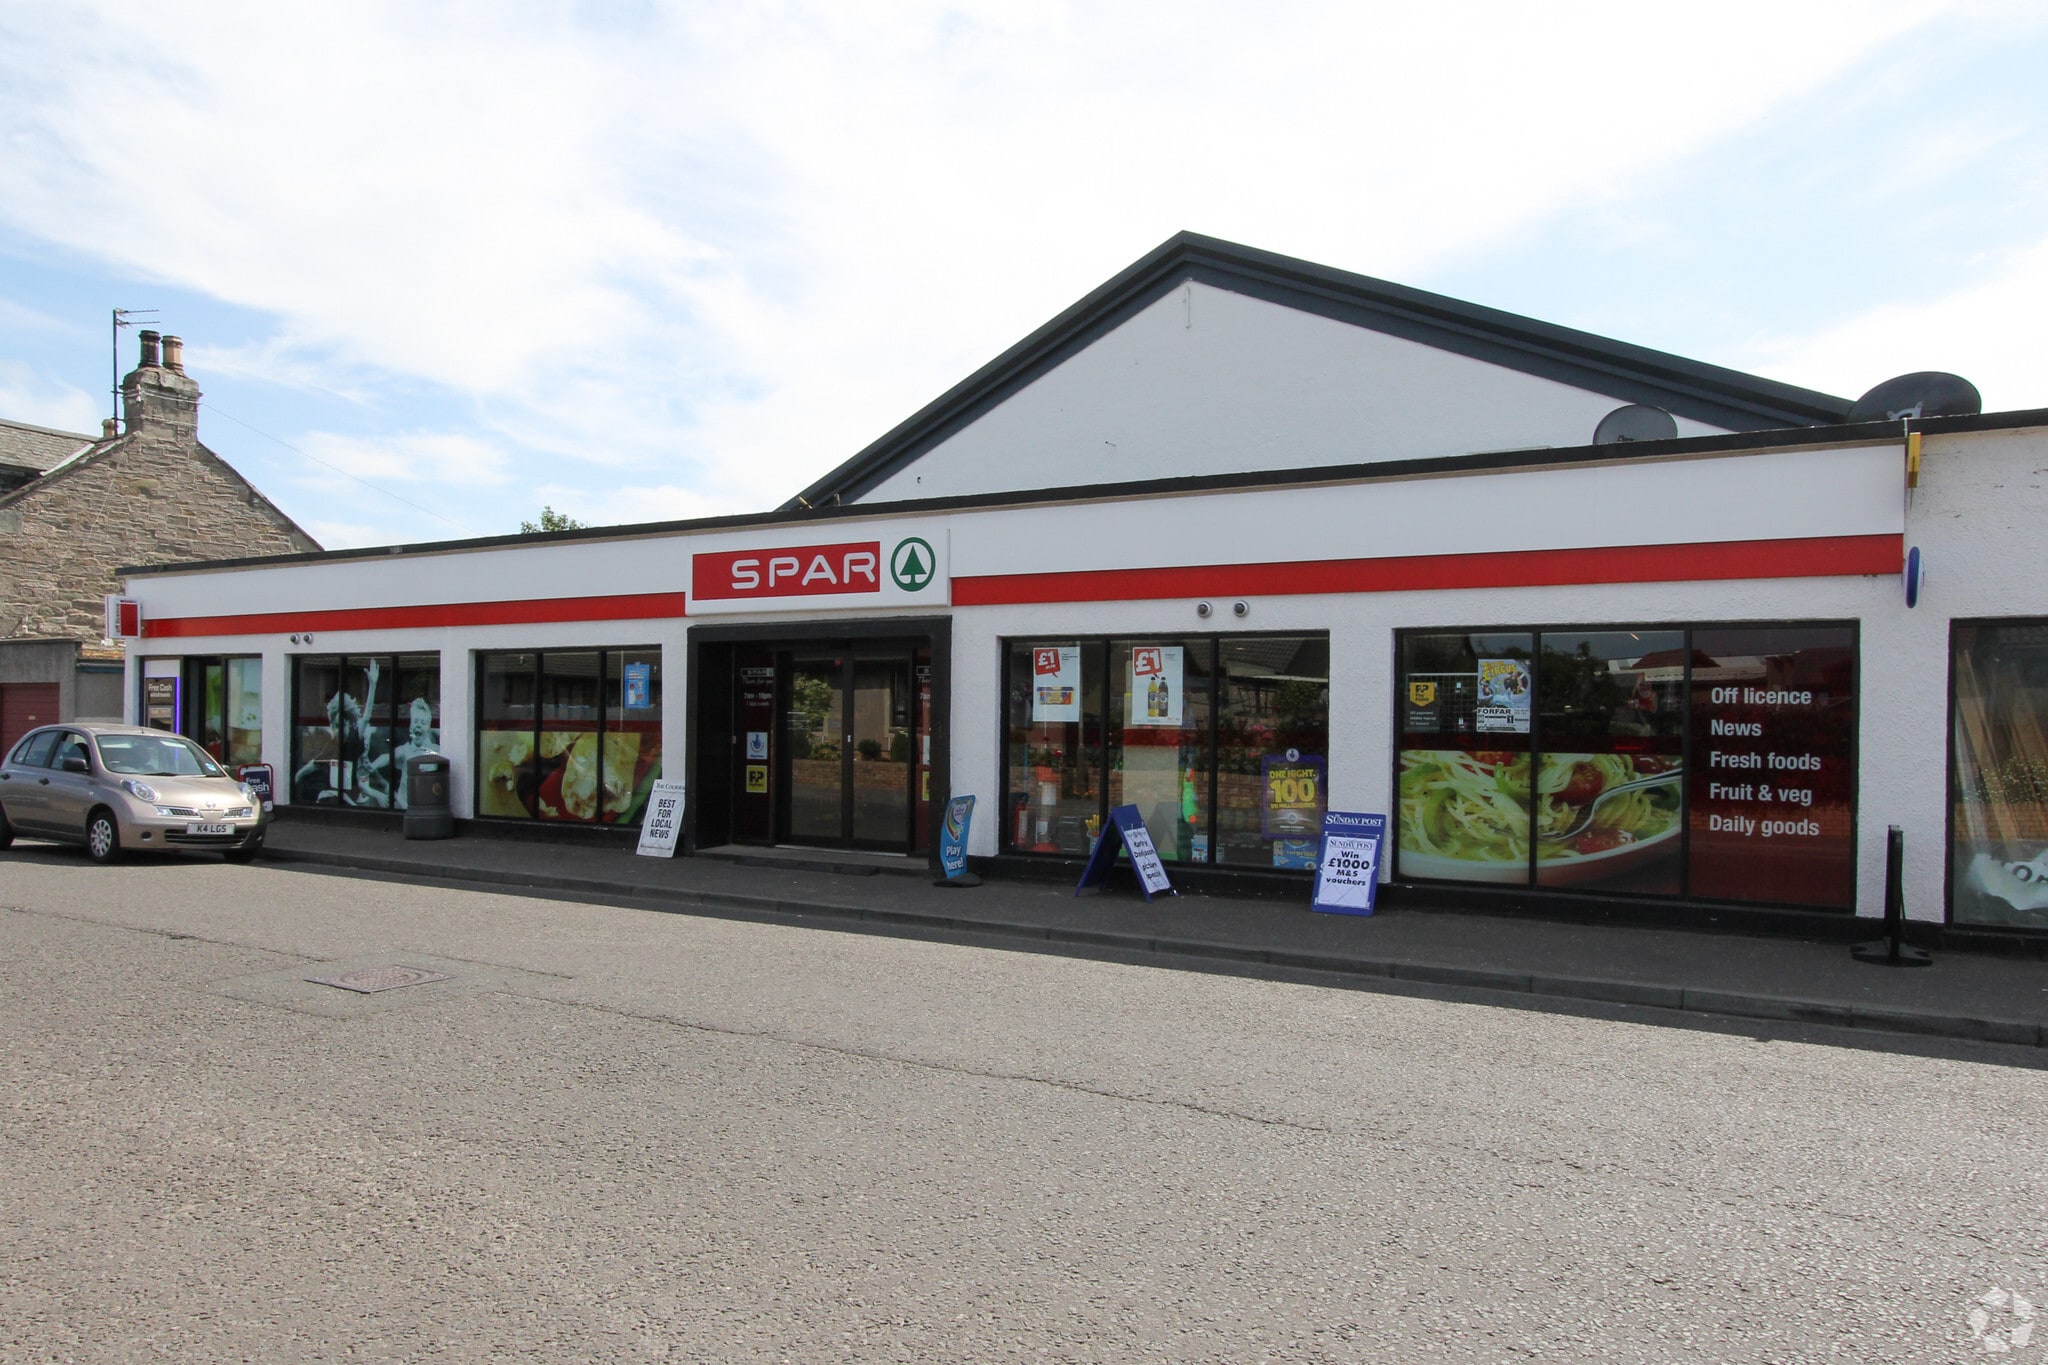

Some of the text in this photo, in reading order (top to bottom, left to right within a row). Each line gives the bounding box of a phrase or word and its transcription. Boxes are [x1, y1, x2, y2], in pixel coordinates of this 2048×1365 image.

[731, 552, 876, 590] SPAR
[1038, 651, 1055, 666] £1
[1136, 650, 1160, 672] £1
[1483, 664, 1517, 682] CIRCUS
[1711, 687, 1812, 704] Off licence
[1711, 719, 1762, 736] News
[1710, 751, 1822, 770] Fresh foods
[1269, 770, 1287, 779] ONE
[251, 783, 270, 791] ash
[1269, 779, 1315, 802] 100
[1710, 783, 1812, 806] Fruit & veg
[658, 799, 676, 808] BEST
[657, 809, 672, 818] FOR
[651, 819, 672, 828] LOCAL
[1325, 814, 1361, 825] SUNDAY
[1361, 818, 1384, 827] POST
[1709, 814, 1820, 837] Daily goods
[210, 825, 227, 833] LGS
[649, 829, 670, 839] NEWS
[946, 845, 962, 857] Play
[1356, 841, 1374, 849] POST
[1341, 851, 1359, 859] Win
[946, 857, 964, 871] here!
[1328, 858, 1370, 870] £1000
[1336, 869, 1358, 877] M&S
[1326, 877, 1367, 886] vouchers
